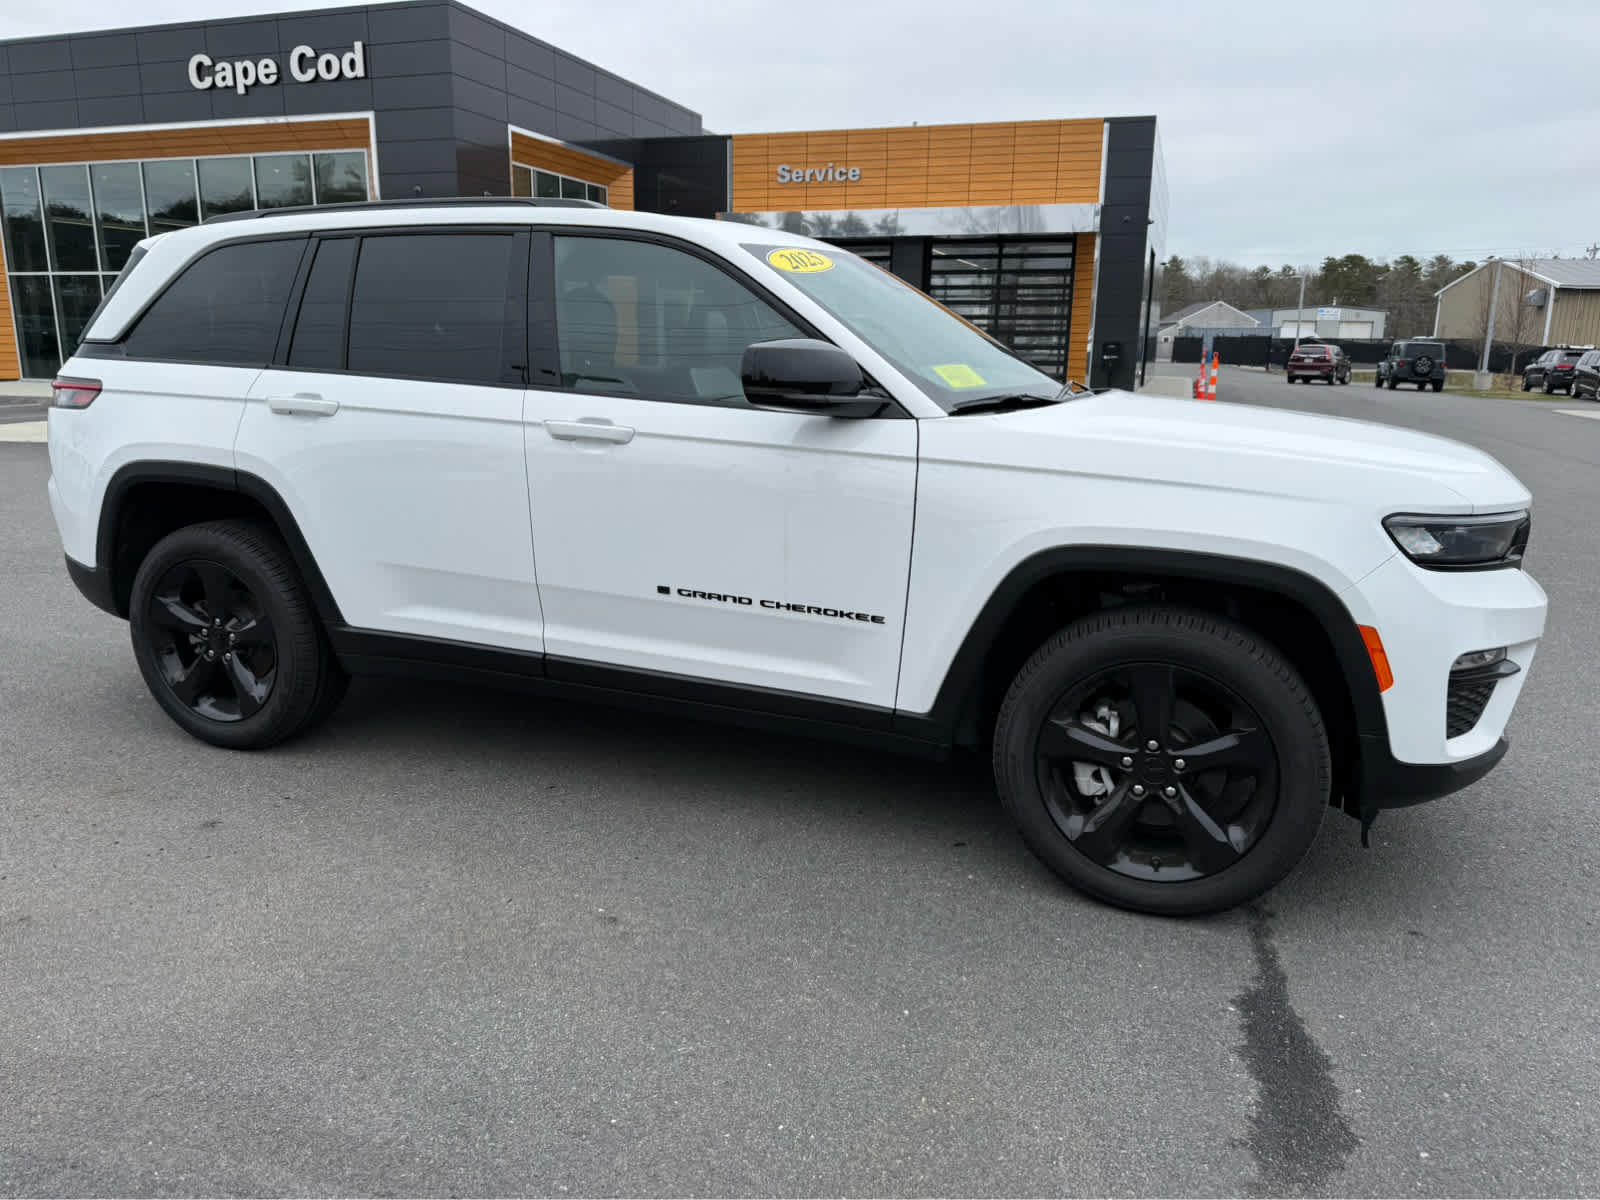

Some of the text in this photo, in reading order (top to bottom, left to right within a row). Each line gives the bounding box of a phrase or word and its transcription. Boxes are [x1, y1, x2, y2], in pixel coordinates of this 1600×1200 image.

[188, 40, 366, 95] Cape Cod
[777, 162, 861, 183] Service
[779, 251, 825, 270] 2025
[676, 588, 886, 625] GRAND CHEROKEE
